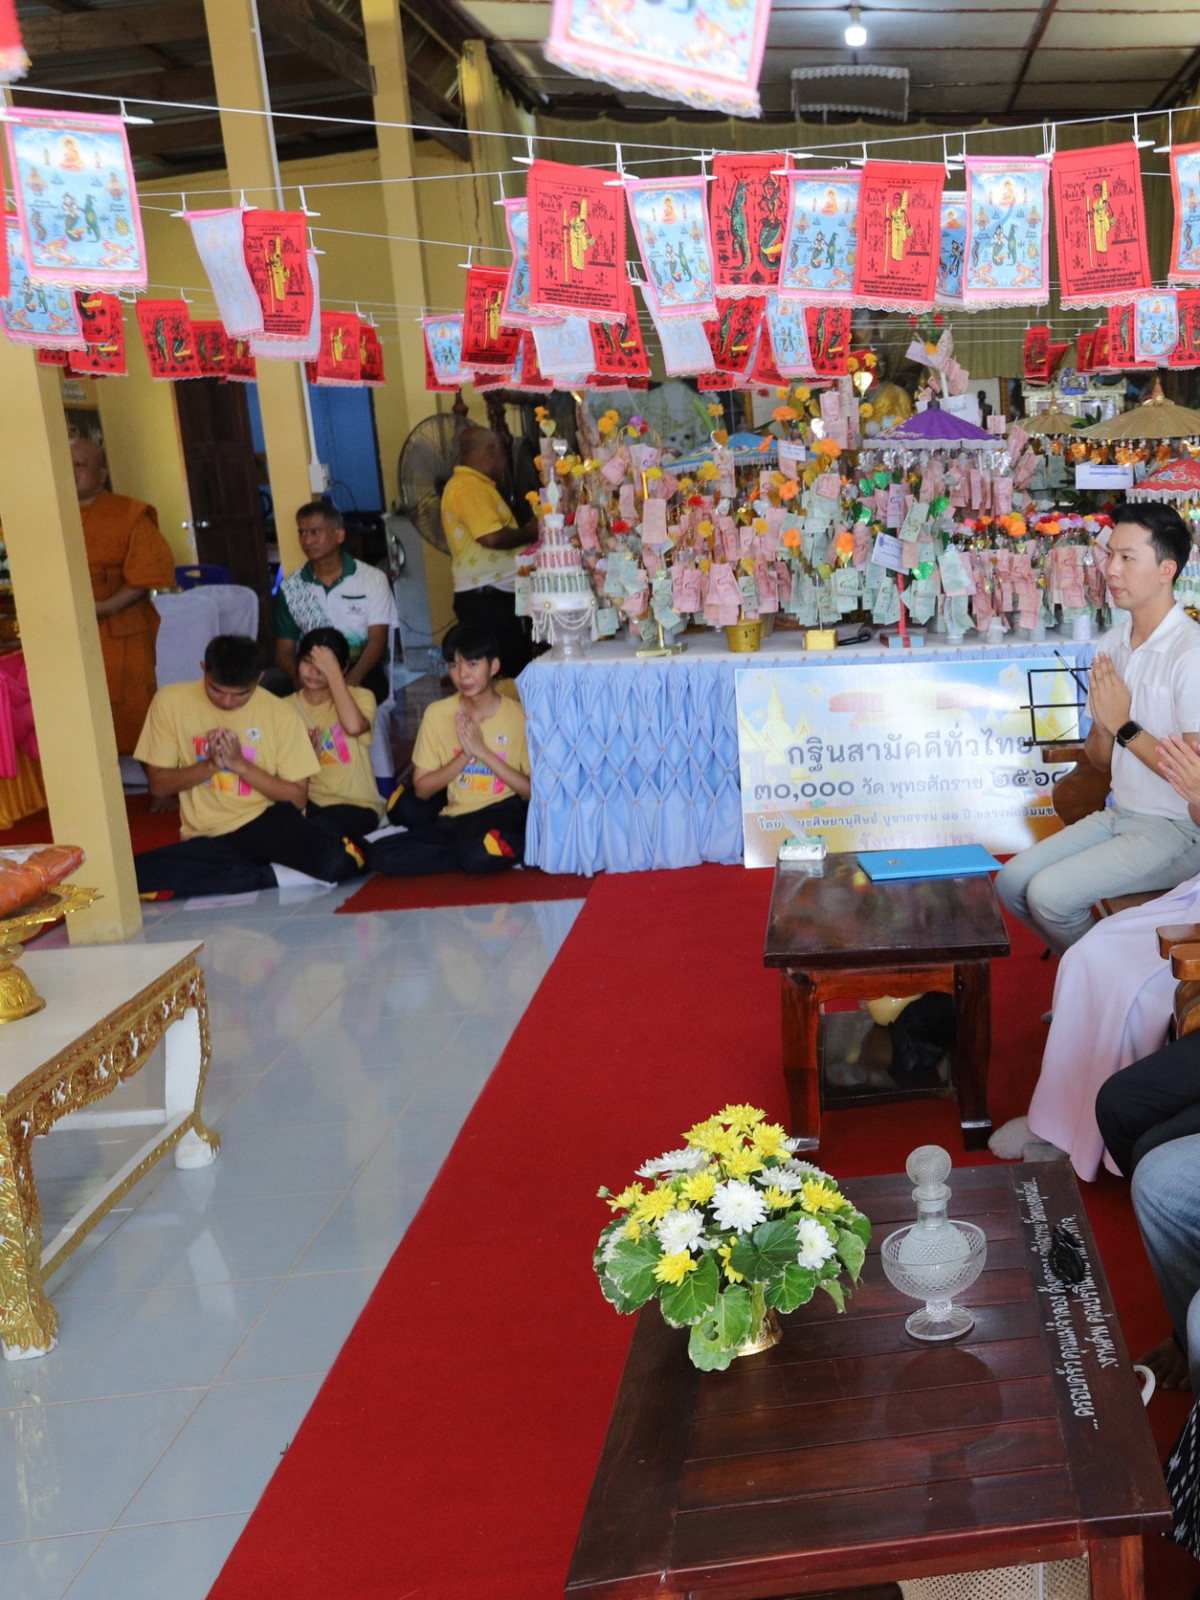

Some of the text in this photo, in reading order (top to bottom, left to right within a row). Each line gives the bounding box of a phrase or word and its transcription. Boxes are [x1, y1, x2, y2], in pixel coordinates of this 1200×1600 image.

[787, 723, 1033, 772] กฐินสามัคคีทั่วไทย
[754, 779, 855, 802] ๓๐,๐๐๐
[862, 776, 885, 796] วัด
[890, 773, 983, 799] พุทธศักราช
[758, 815, 782, 830] โดย
[795, 812, 878, 829] ะศิษยานุศิษย์
[963, 808, 972, 820] ปี
[976, 806, 1055, 819] หลวงพ่อธัมมช
[1045, 1295, 1089, 1359] คุณแม่จำลอง
